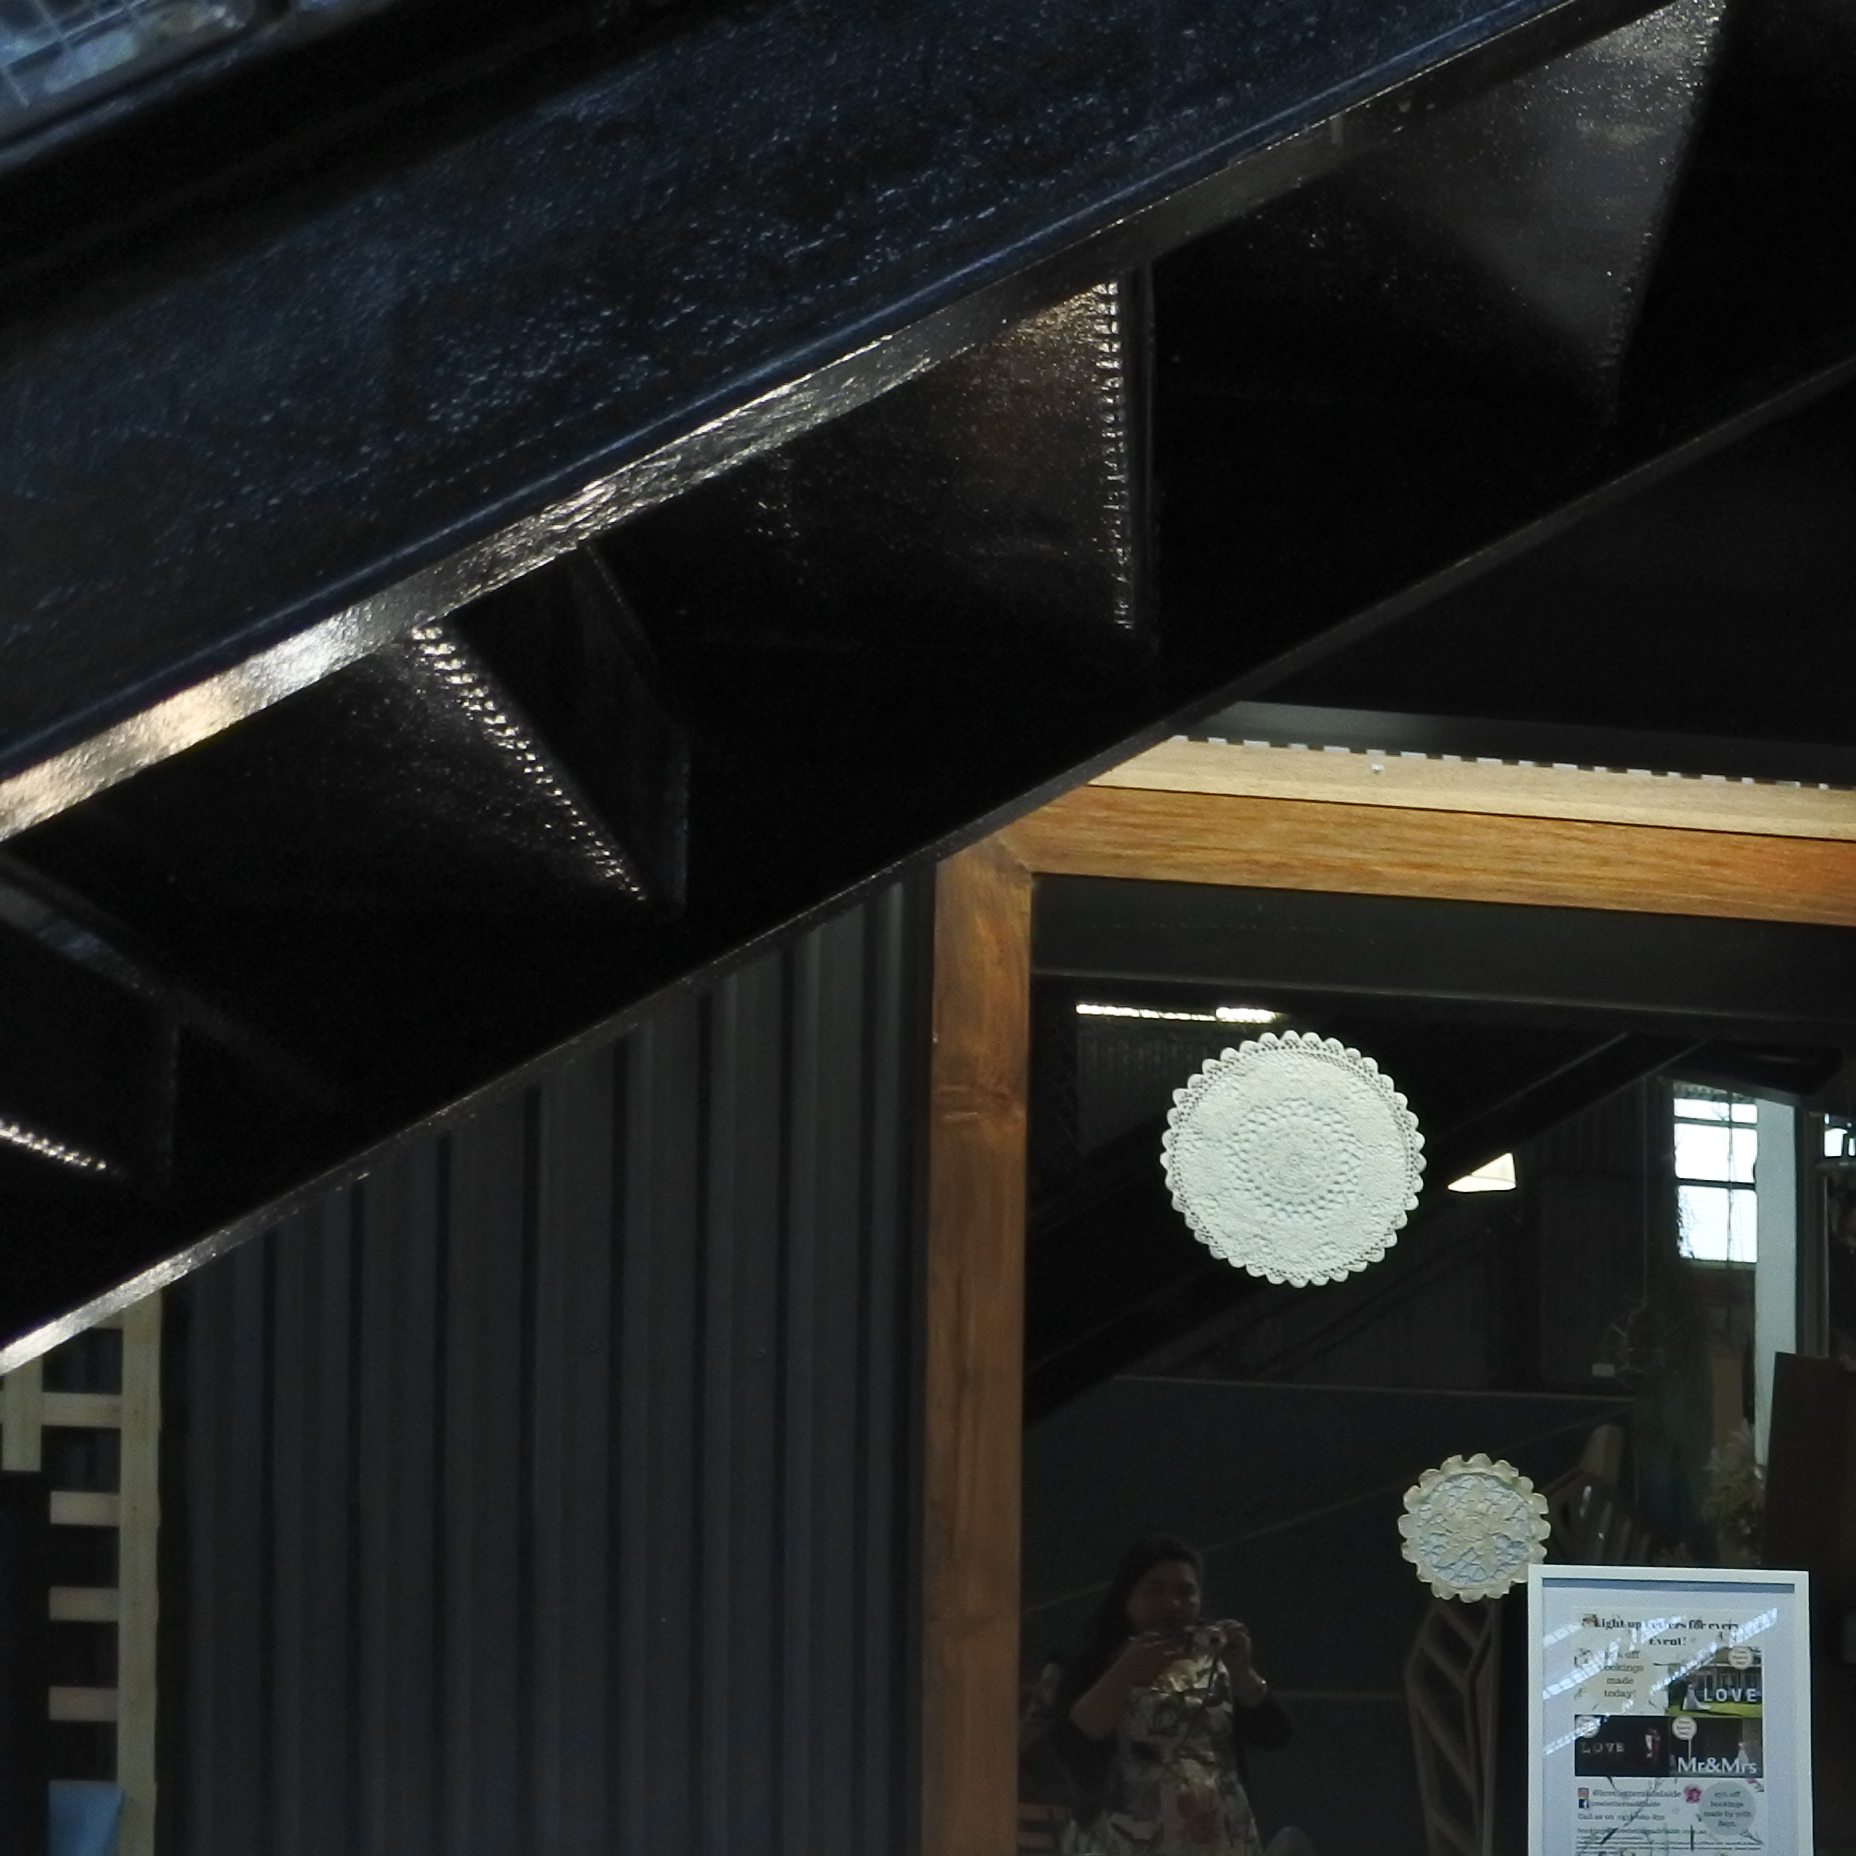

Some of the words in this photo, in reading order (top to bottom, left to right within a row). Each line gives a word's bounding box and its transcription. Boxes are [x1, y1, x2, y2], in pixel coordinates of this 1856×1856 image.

[1628, 1621, 1642, 1631] up
[1600, 1662, 1645, 1674] ookings
[1606, 1677, 1635, 1685] made
[1703, 1687, 1757, 1703] LOVE
[1677, 1757, 1758, 1774] Mr&Mrs
